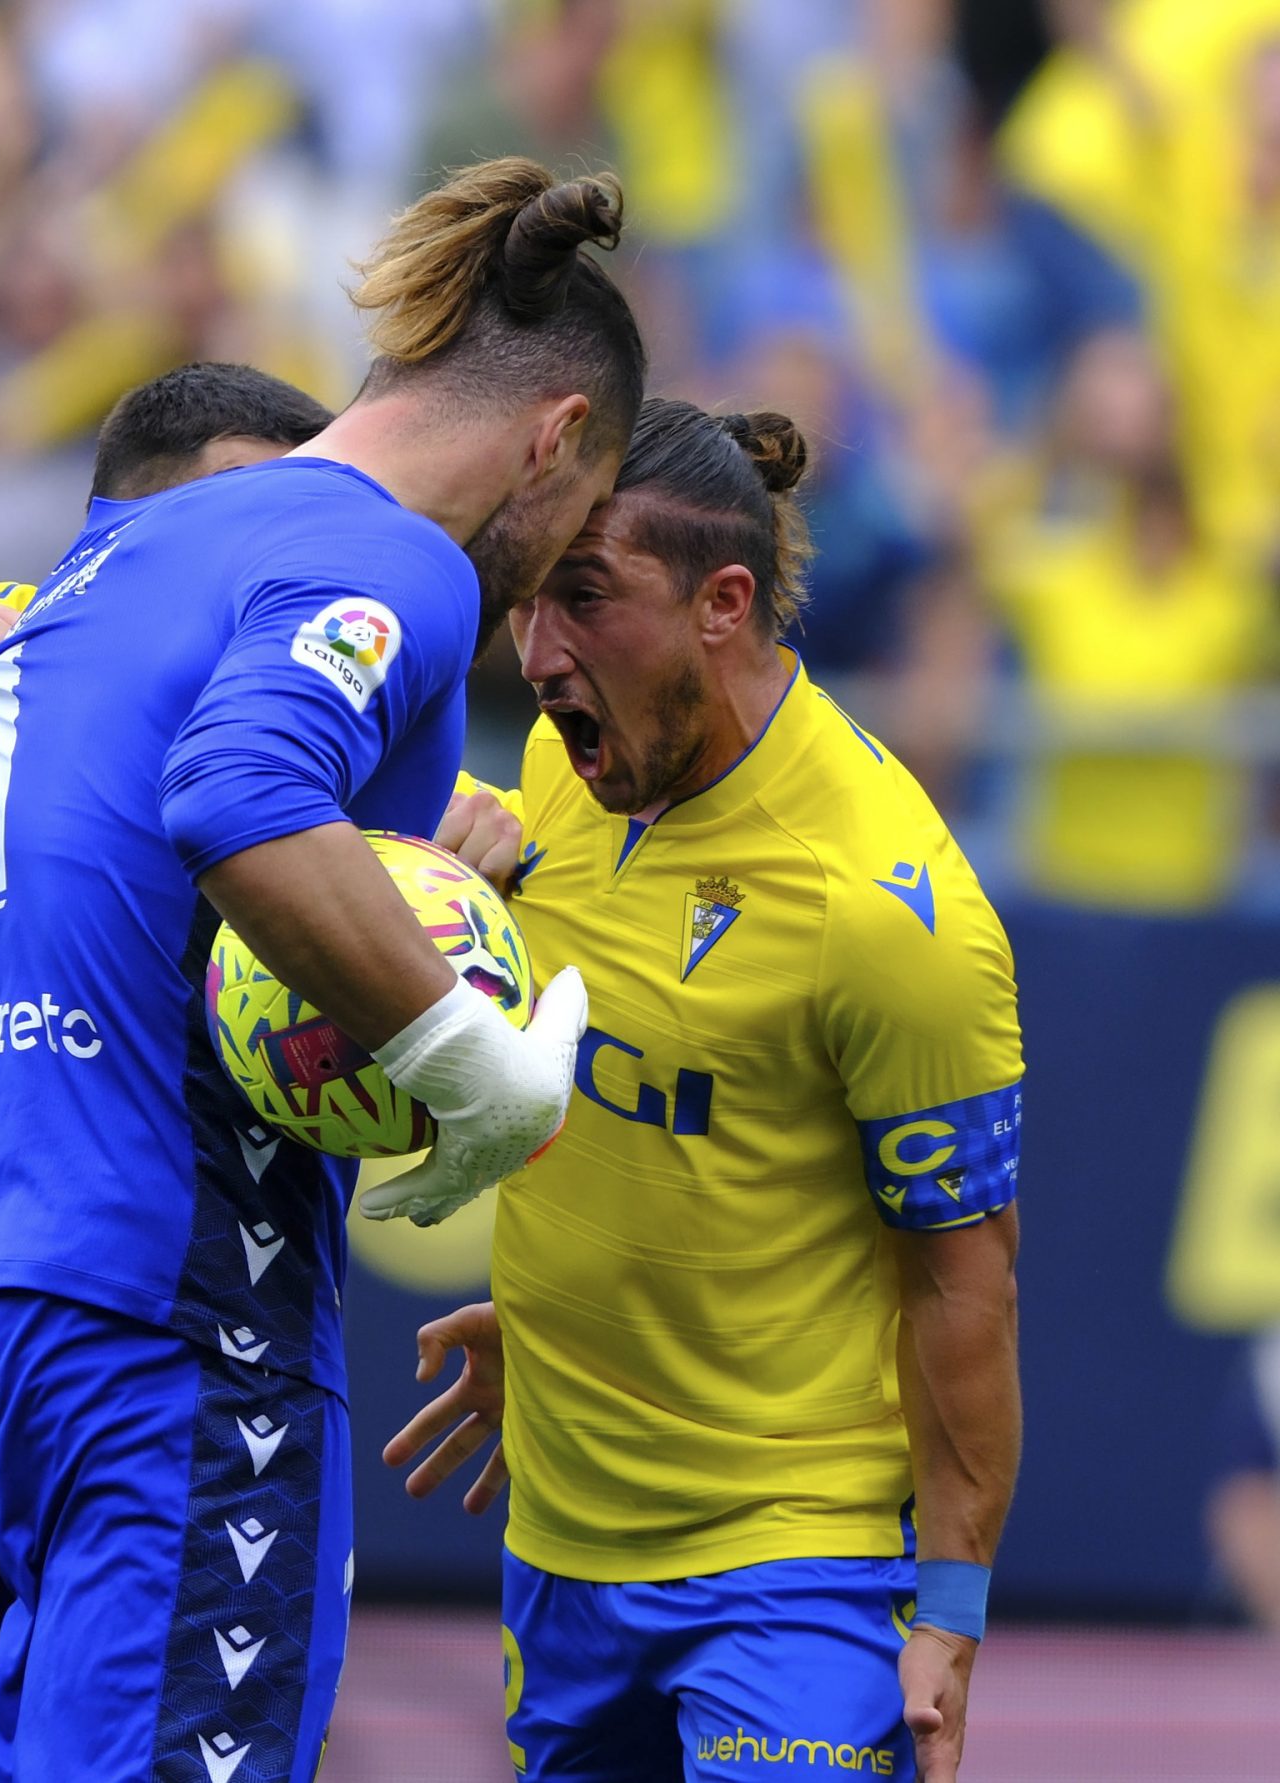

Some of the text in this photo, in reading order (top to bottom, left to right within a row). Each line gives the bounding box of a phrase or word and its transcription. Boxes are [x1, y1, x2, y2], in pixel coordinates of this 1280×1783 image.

[303, 642, 364, 696] LaLiga
[877, 1119, 957, 1176] C
[993, 1119, 1012, 1136] EL
[697, 1727, 894, 1776] wehumans
